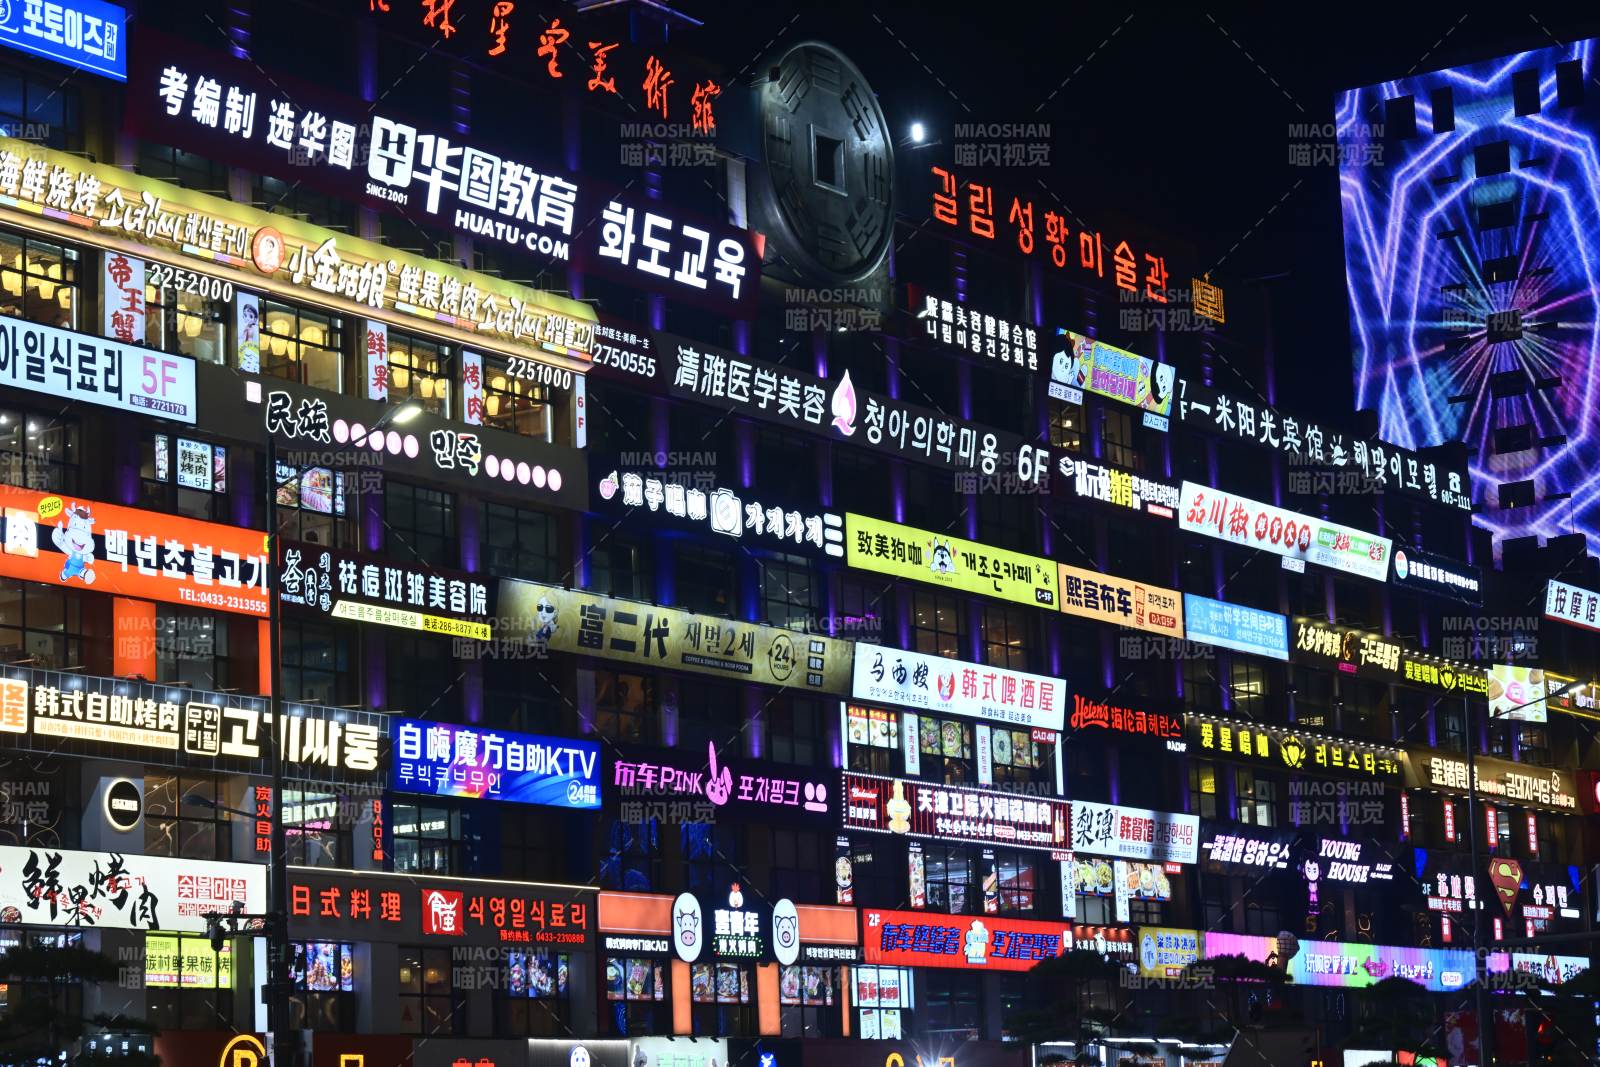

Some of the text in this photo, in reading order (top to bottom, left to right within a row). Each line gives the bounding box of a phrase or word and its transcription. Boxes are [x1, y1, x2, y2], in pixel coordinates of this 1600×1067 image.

[23, 0, 117, 60] 포토이즈 카페
[160, 65, 356, 169] 考编制 选华图
[366, 183, 408, 205] SINCE 2001
[414, 134, 577, 236] 华图教育
[184, 211, 250, 260] 해산물구이
[598, 200, 746, 299] 화도교육
[107, 254, 144, 342] 帝王蟹
[150, 264, 233, 303] 2252000
[397, 262, 480, 321] 鲜果烤肉
[544, 313, 595, 353] 과일불고기
[142, 355, 178, 397] 5F
[366, 329, 389, 392] 鲜果
[506, 356, 571, 391] 2251000
[592, 343, 656, 378] 2750555
[462, 360, 484, 426] 烤肉
[674, 344, 826, 424] 清雅医学美容
[150, 398, 186, 416] 2721178
[266, 390, 331, 443] 民族
[864, 397, 1000, 475] 청아의학미용
[1190, 394, 1324, 462] 一米阳光宾馆
[180, 449, 208, 465] 韩式
[180, 462, 208, 477] 烤肉
[1017, 443, 1050, 485] 6F
[1353, 440, 1439, 500] 해맞이모텔
[104, 529, 268, 595] 백년초불고기
[857, 530, 923, 565] 致美狗咖
[338, 559, 488, 616] 祛痘斑皱美容院
[961, 551, 1032, 592] 개조은카페
[178, 587, 268, 613] TEL:0433-2313555
[1553, 584, 1599, 624] 按摩馆
[577, 603, 670, 659] 富二代
[684, 621, 755, 659] 재벌2세
[774, 642, 790, 663] 24
[34, 685, 180, 732] 韩式自助烤肉
[961, 668, 1055, 712] 韩式啤酒屋
[1110, 706, 1147, 735] 海伦司
[1200, 723, 1270, 758] 爱星唱咖
[400, 763, 501, 794] 루빅큐브무인
[1314, 743, 1377, 777] 러브스타
[738, 775, 800, 806] 포차핑크
[256, 786, 272, 852] 炭火自助
[1319, 839, 1362, 862] YOUNG
[1327, 861, 1371, 884] HOUSE
[291, 884, 402, 921] 日式料理
[468, 896, 588, 930] 식영일식료리
[868, 913, 881, 927] 2F
